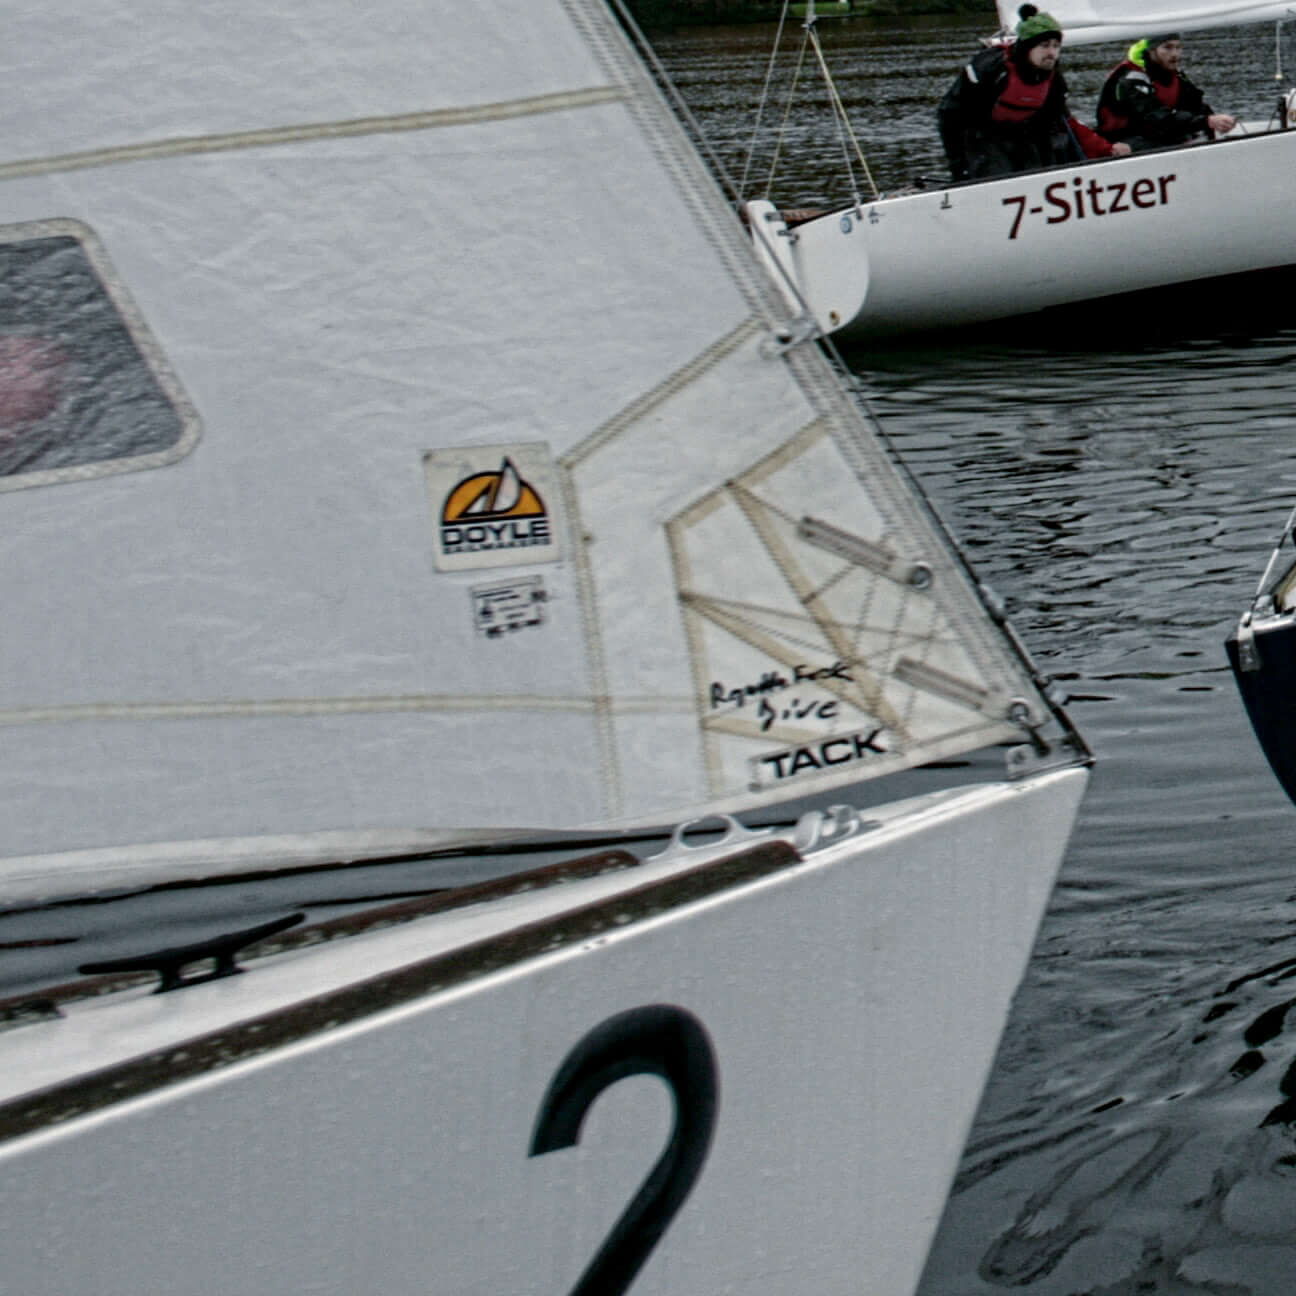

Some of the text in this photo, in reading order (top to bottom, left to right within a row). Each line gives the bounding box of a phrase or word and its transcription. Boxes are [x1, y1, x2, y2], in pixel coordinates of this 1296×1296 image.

[1002, 174, 1177, 240] 7-Sitzer
[441, 519, 550, 547] DOYLE
[762, 727, 887, 778] TACK
[527, 1002, 721, 1296] 2
